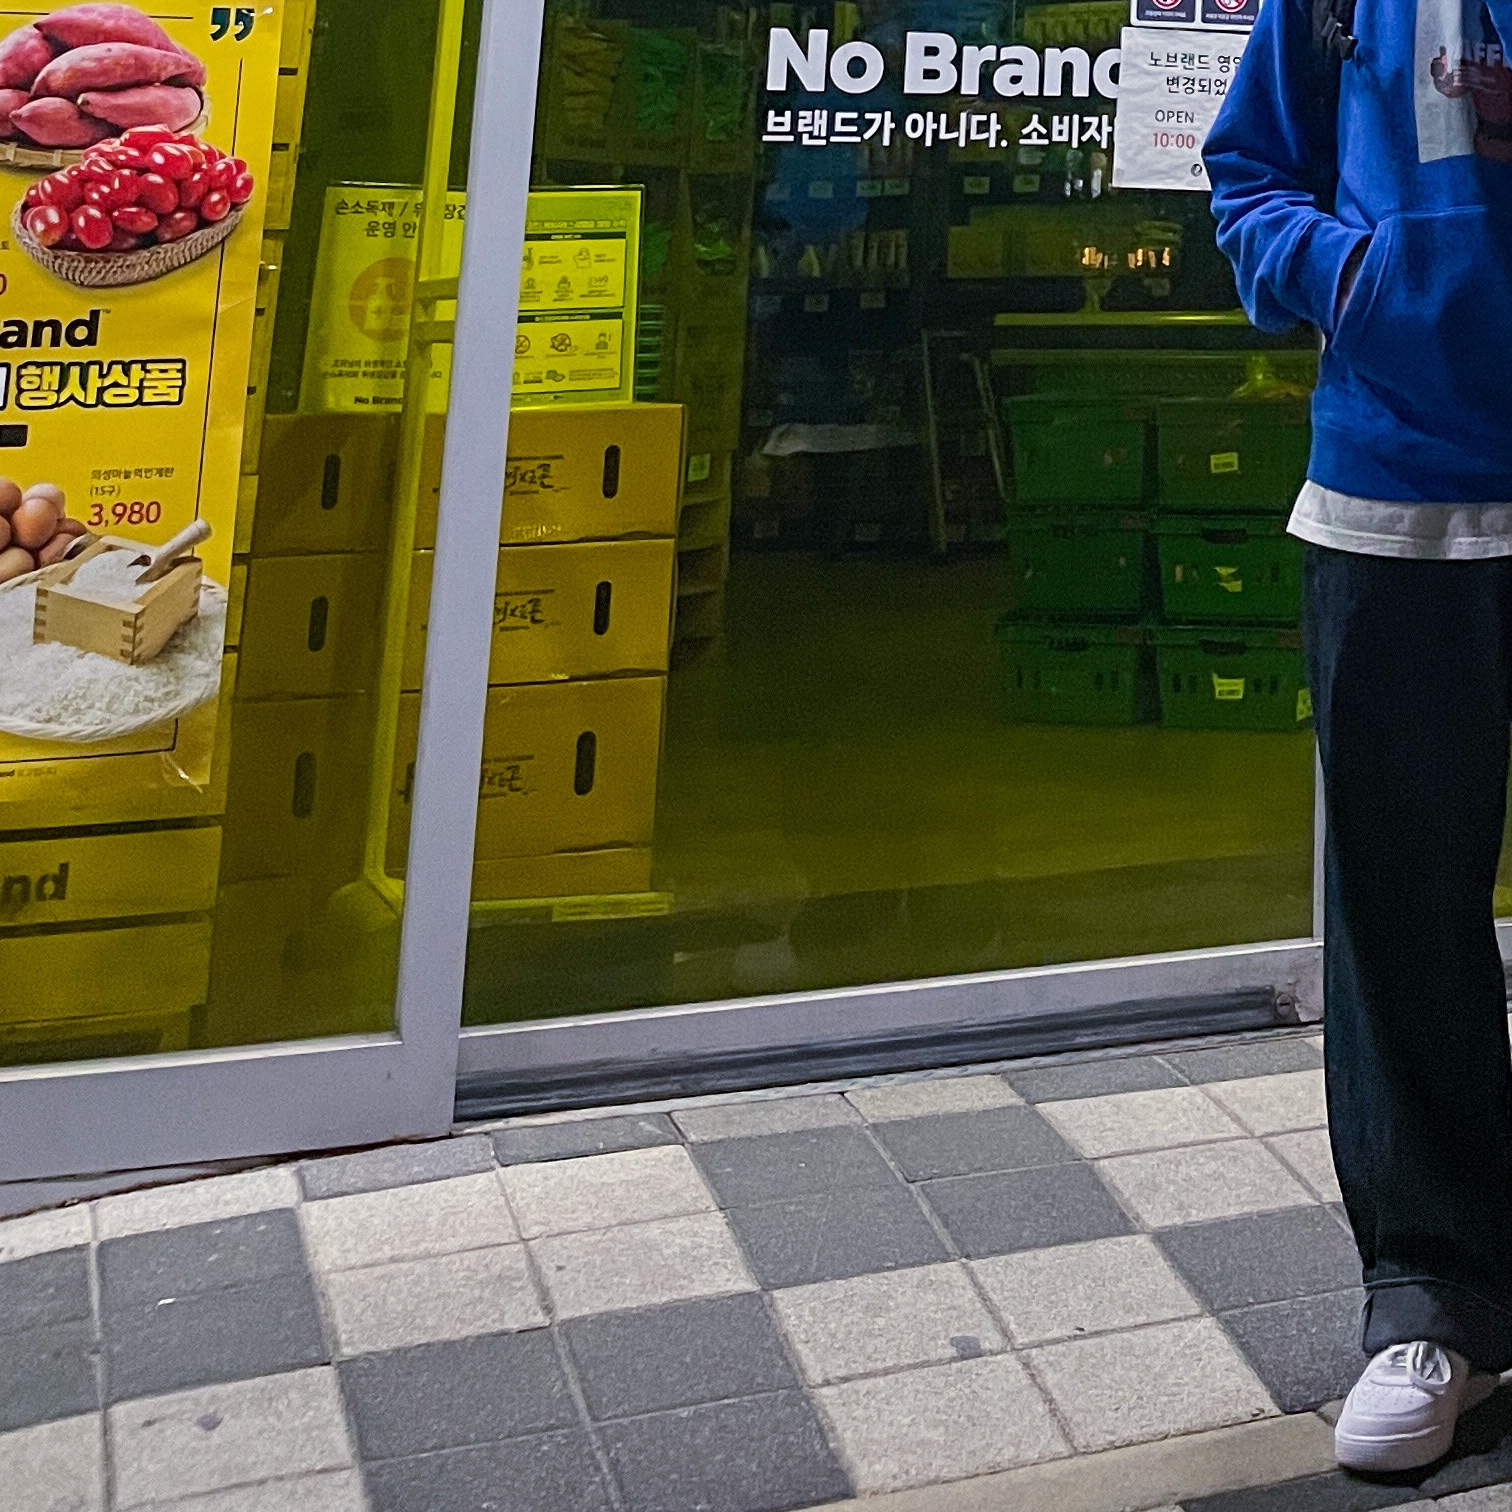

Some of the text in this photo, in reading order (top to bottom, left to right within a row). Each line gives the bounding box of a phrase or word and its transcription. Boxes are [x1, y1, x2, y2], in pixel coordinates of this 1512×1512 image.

[765, 27, 885, 94] No
[1149, 51, 1211, 71] 노브랜드
[1154, 110, 1195, 124] OPEN
[762, 109, 896, 145] 브랜드가
[904, 112, 1009, 148] 아니다.
[1151, 133, 1196, 149] 10:00
[365, 220, 397, 239] 운영
[17, 359, 187, 410] 행사상품
[354, 396, 370, 405] No
[87, 500, 162, 528] 3,980
